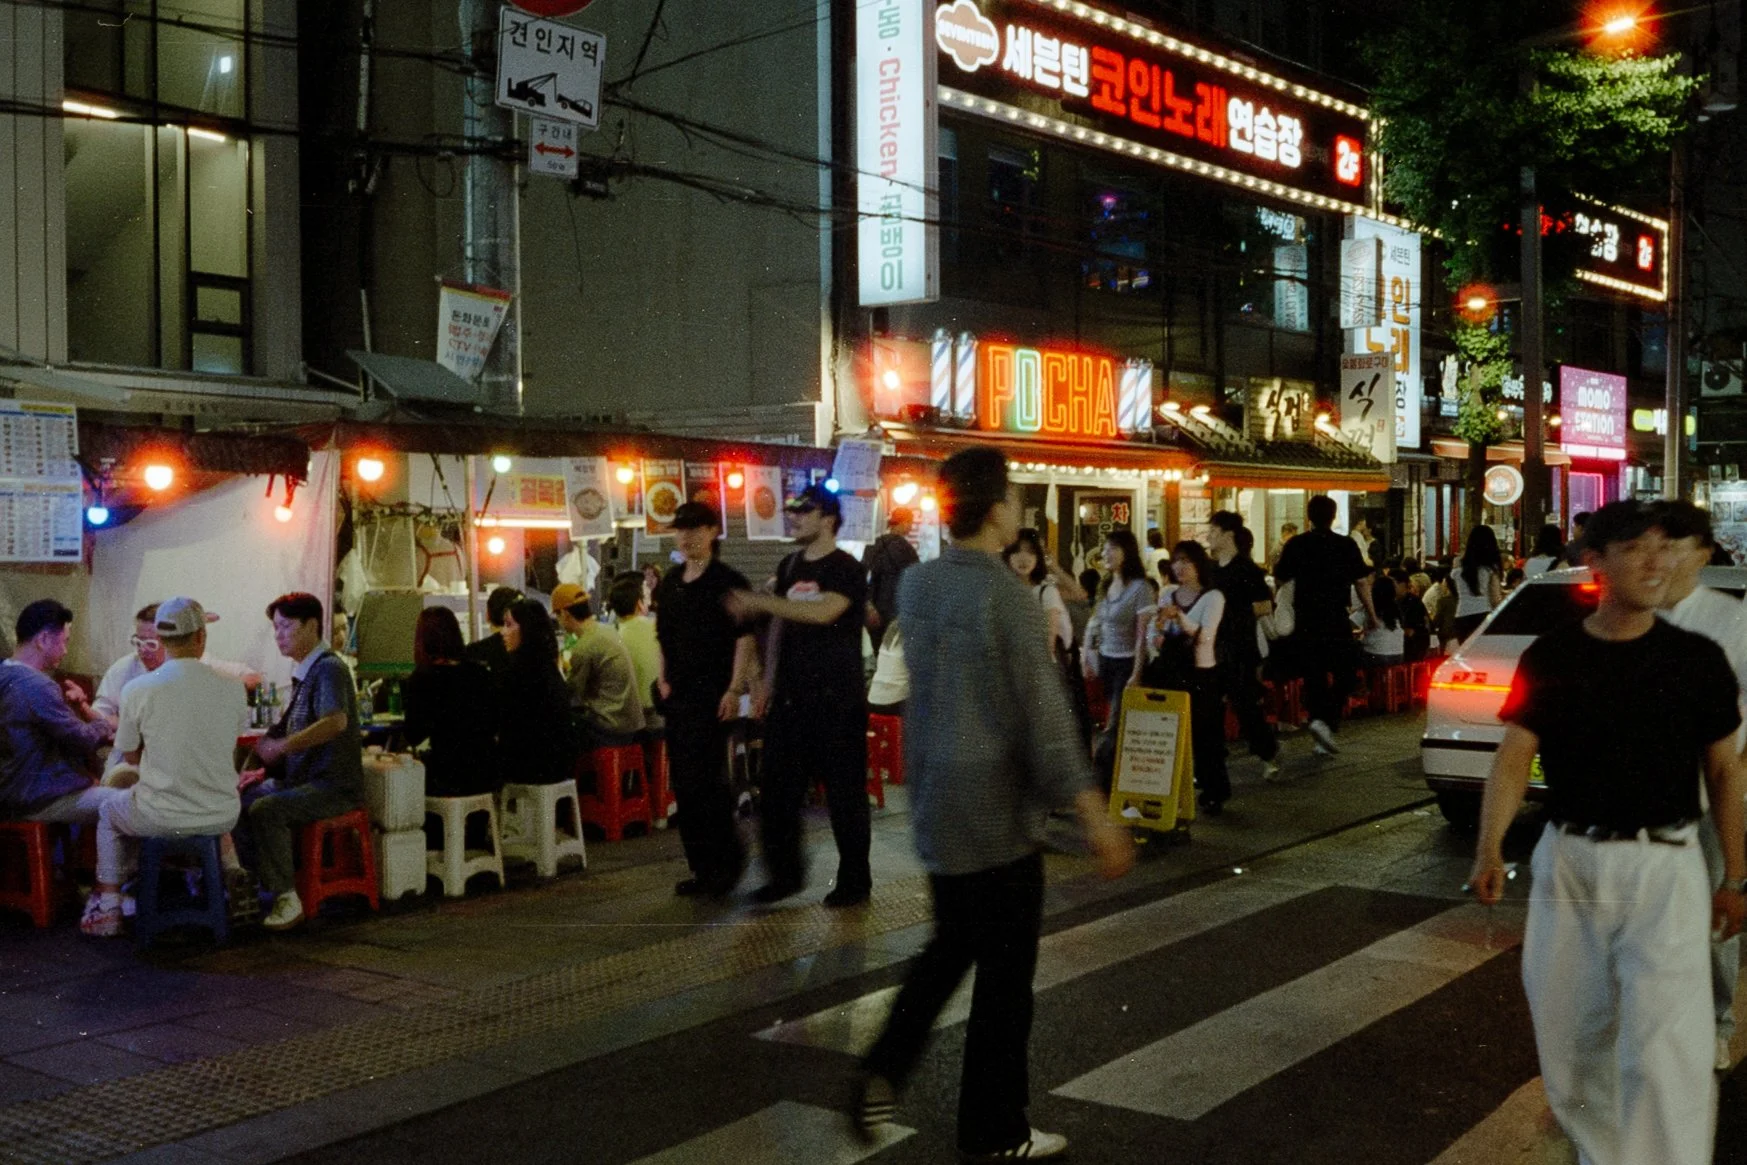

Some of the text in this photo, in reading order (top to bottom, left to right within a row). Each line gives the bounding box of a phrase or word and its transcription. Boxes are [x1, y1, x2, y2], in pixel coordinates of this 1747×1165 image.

[510, 20, 599, 67] 견인지역
[538, 124, 572, 141] 구간내
[879, 57, 901, 178] Chicken
[1003, 24, 1303, 168] 세븐틴 코인노래 연습장
[987, 346, 1118, 438] POCHA
